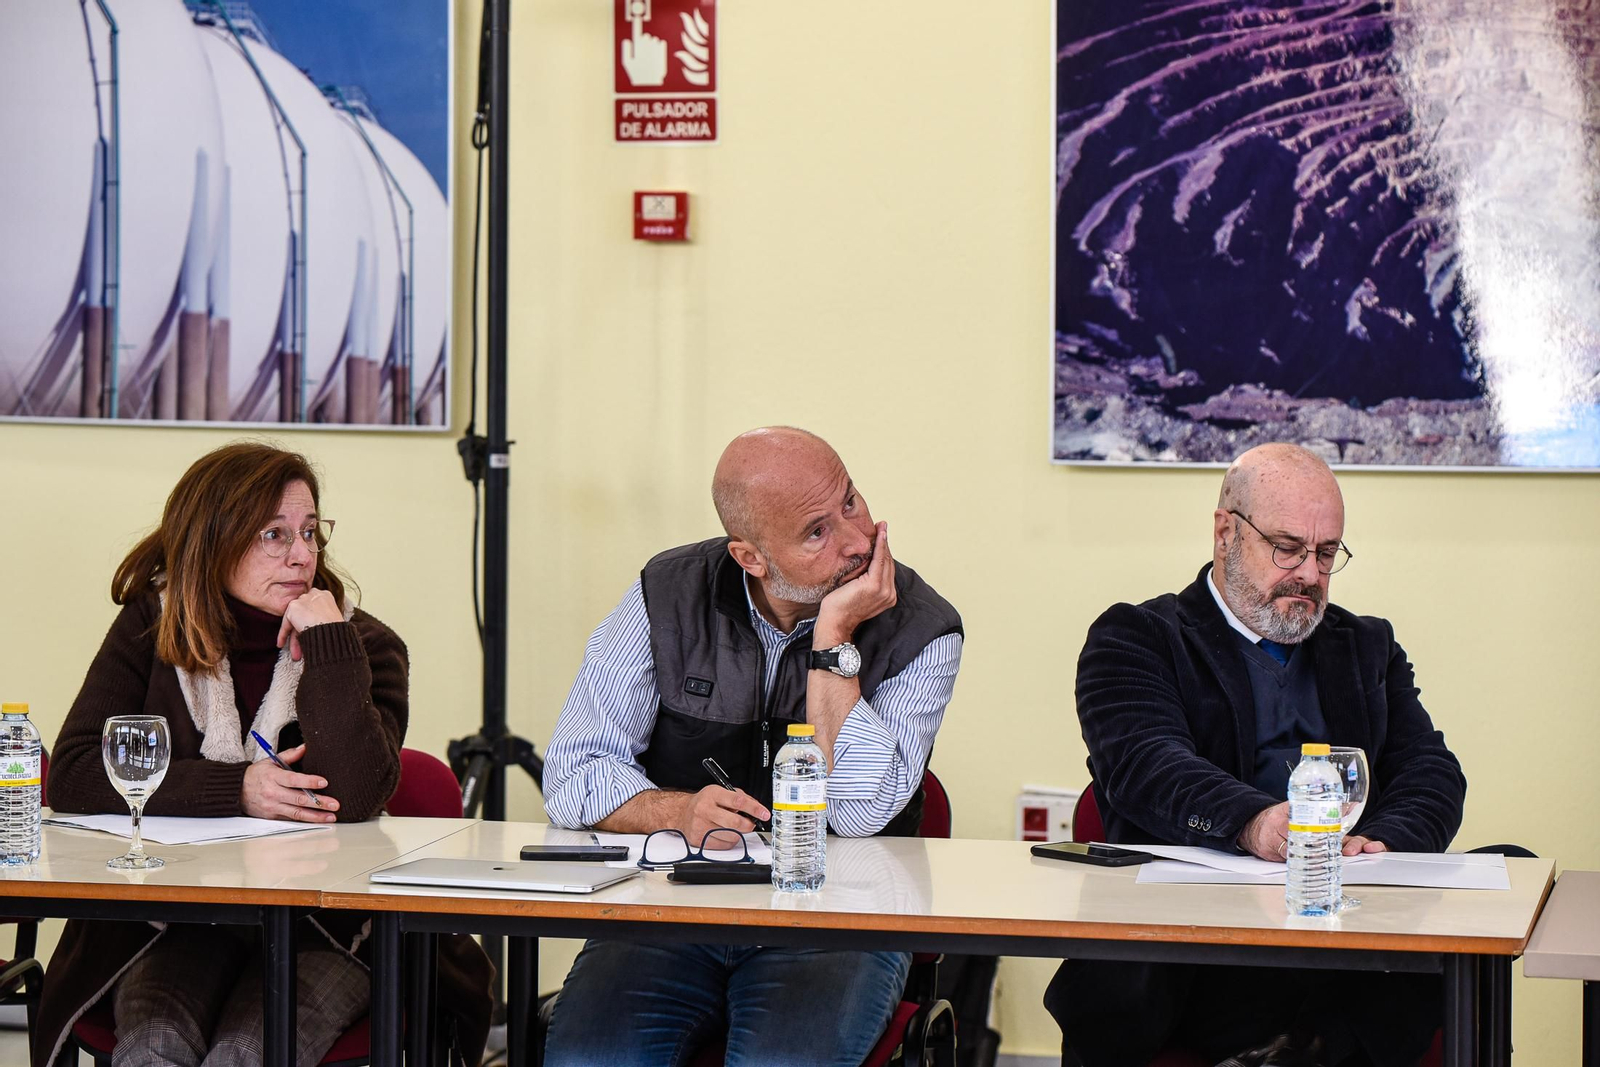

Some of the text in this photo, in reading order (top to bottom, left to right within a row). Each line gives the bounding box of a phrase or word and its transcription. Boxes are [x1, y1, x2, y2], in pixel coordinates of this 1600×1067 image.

[621, 102, 709, 119] PULSADOR
[619, 121, 712, 138] DE ALARMA
